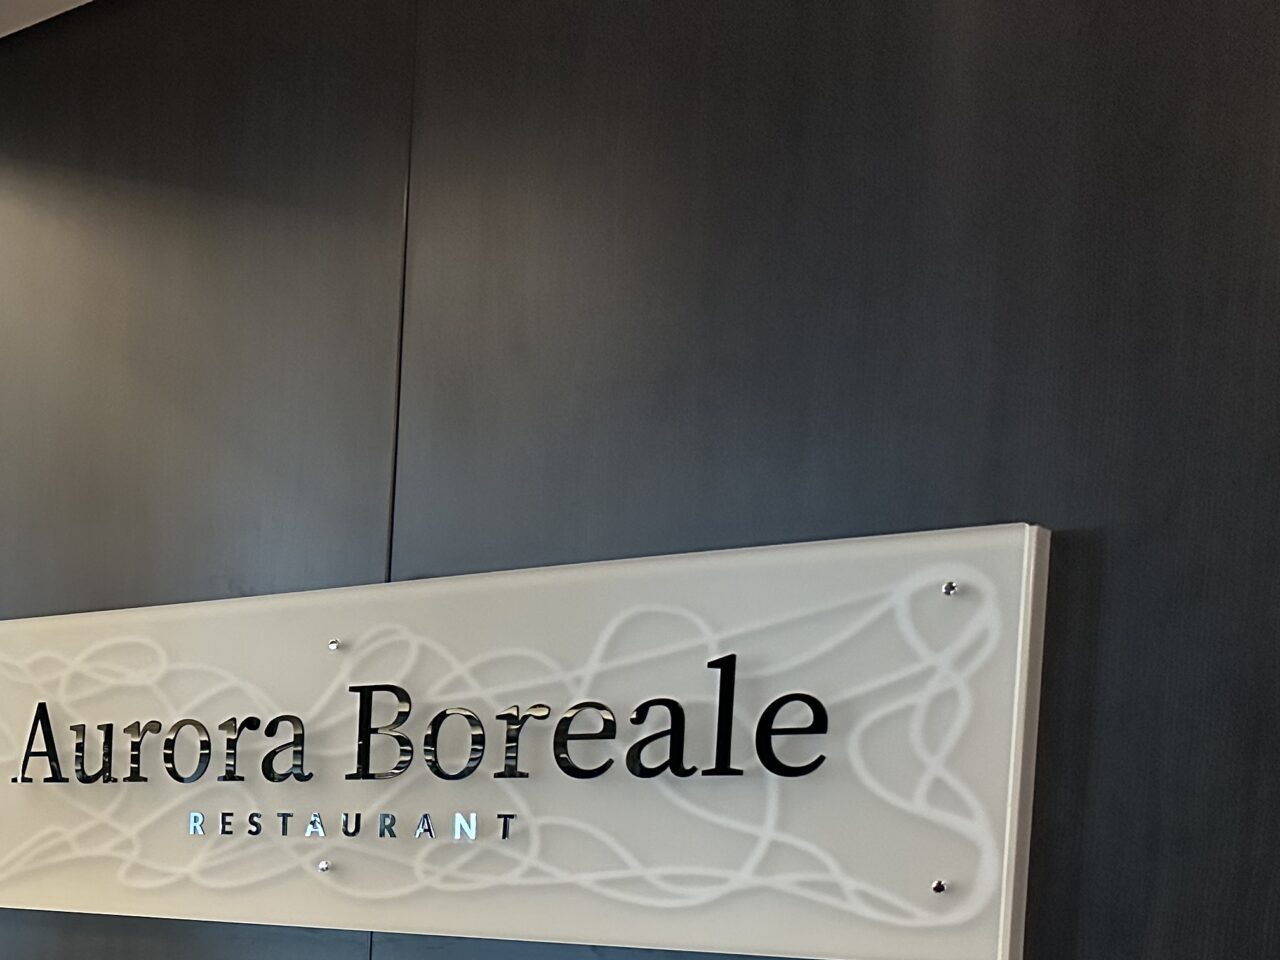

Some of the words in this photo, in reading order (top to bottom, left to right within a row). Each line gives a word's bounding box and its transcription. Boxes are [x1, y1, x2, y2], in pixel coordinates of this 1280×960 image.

[10, 700, 314, 784] Aurora
[344, 653, 830, 781] Boreale
[189, 811, 518, 841] RESTAURANT
